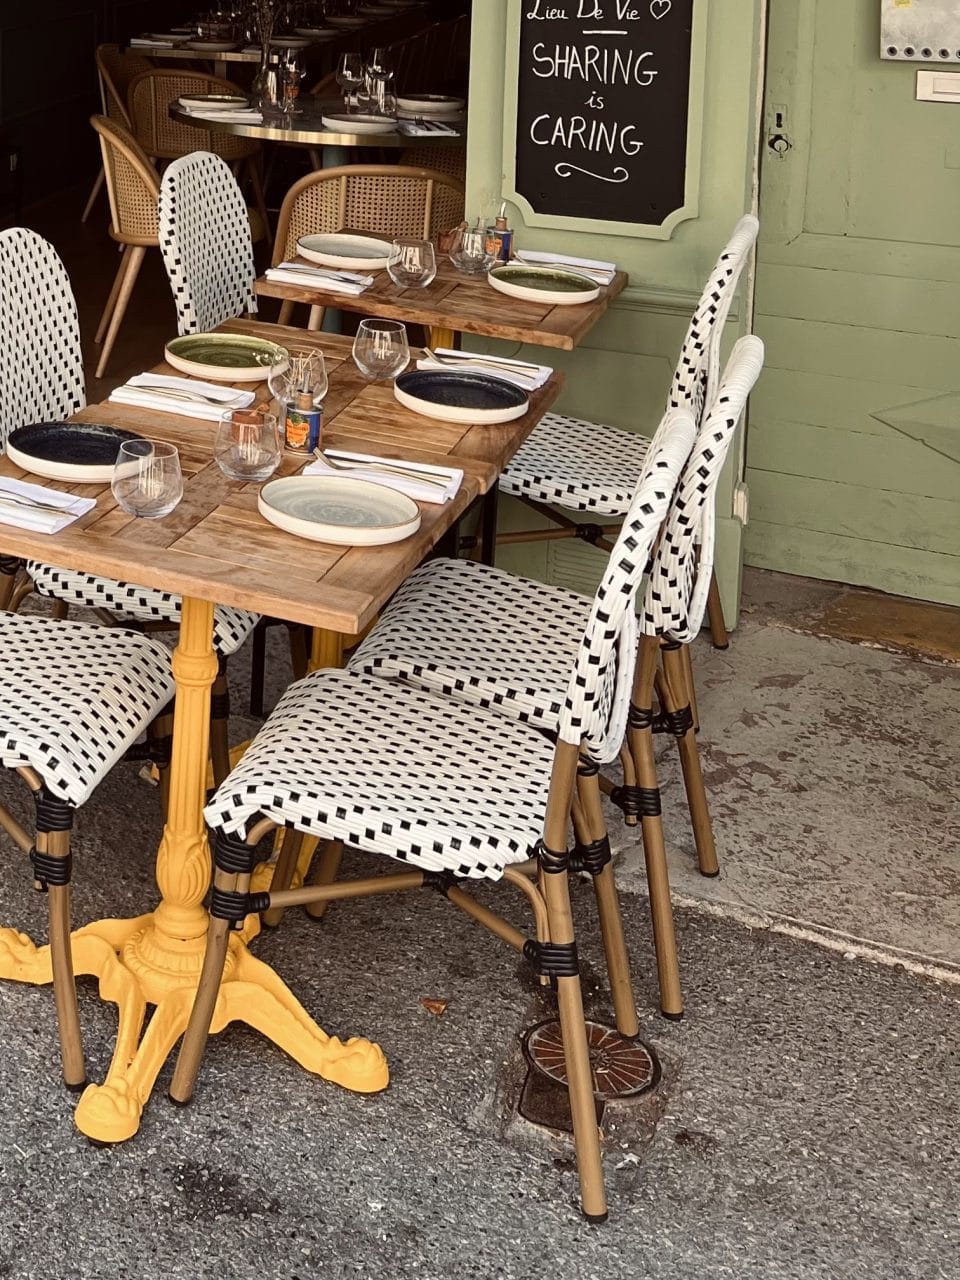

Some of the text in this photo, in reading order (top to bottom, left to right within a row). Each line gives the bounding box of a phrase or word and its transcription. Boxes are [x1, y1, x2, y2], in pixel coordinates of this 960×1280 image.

[532, 42, 658, 86] SHARING
[585, 91, 604, 110] is
[530, 114, 644, 156] CARING
